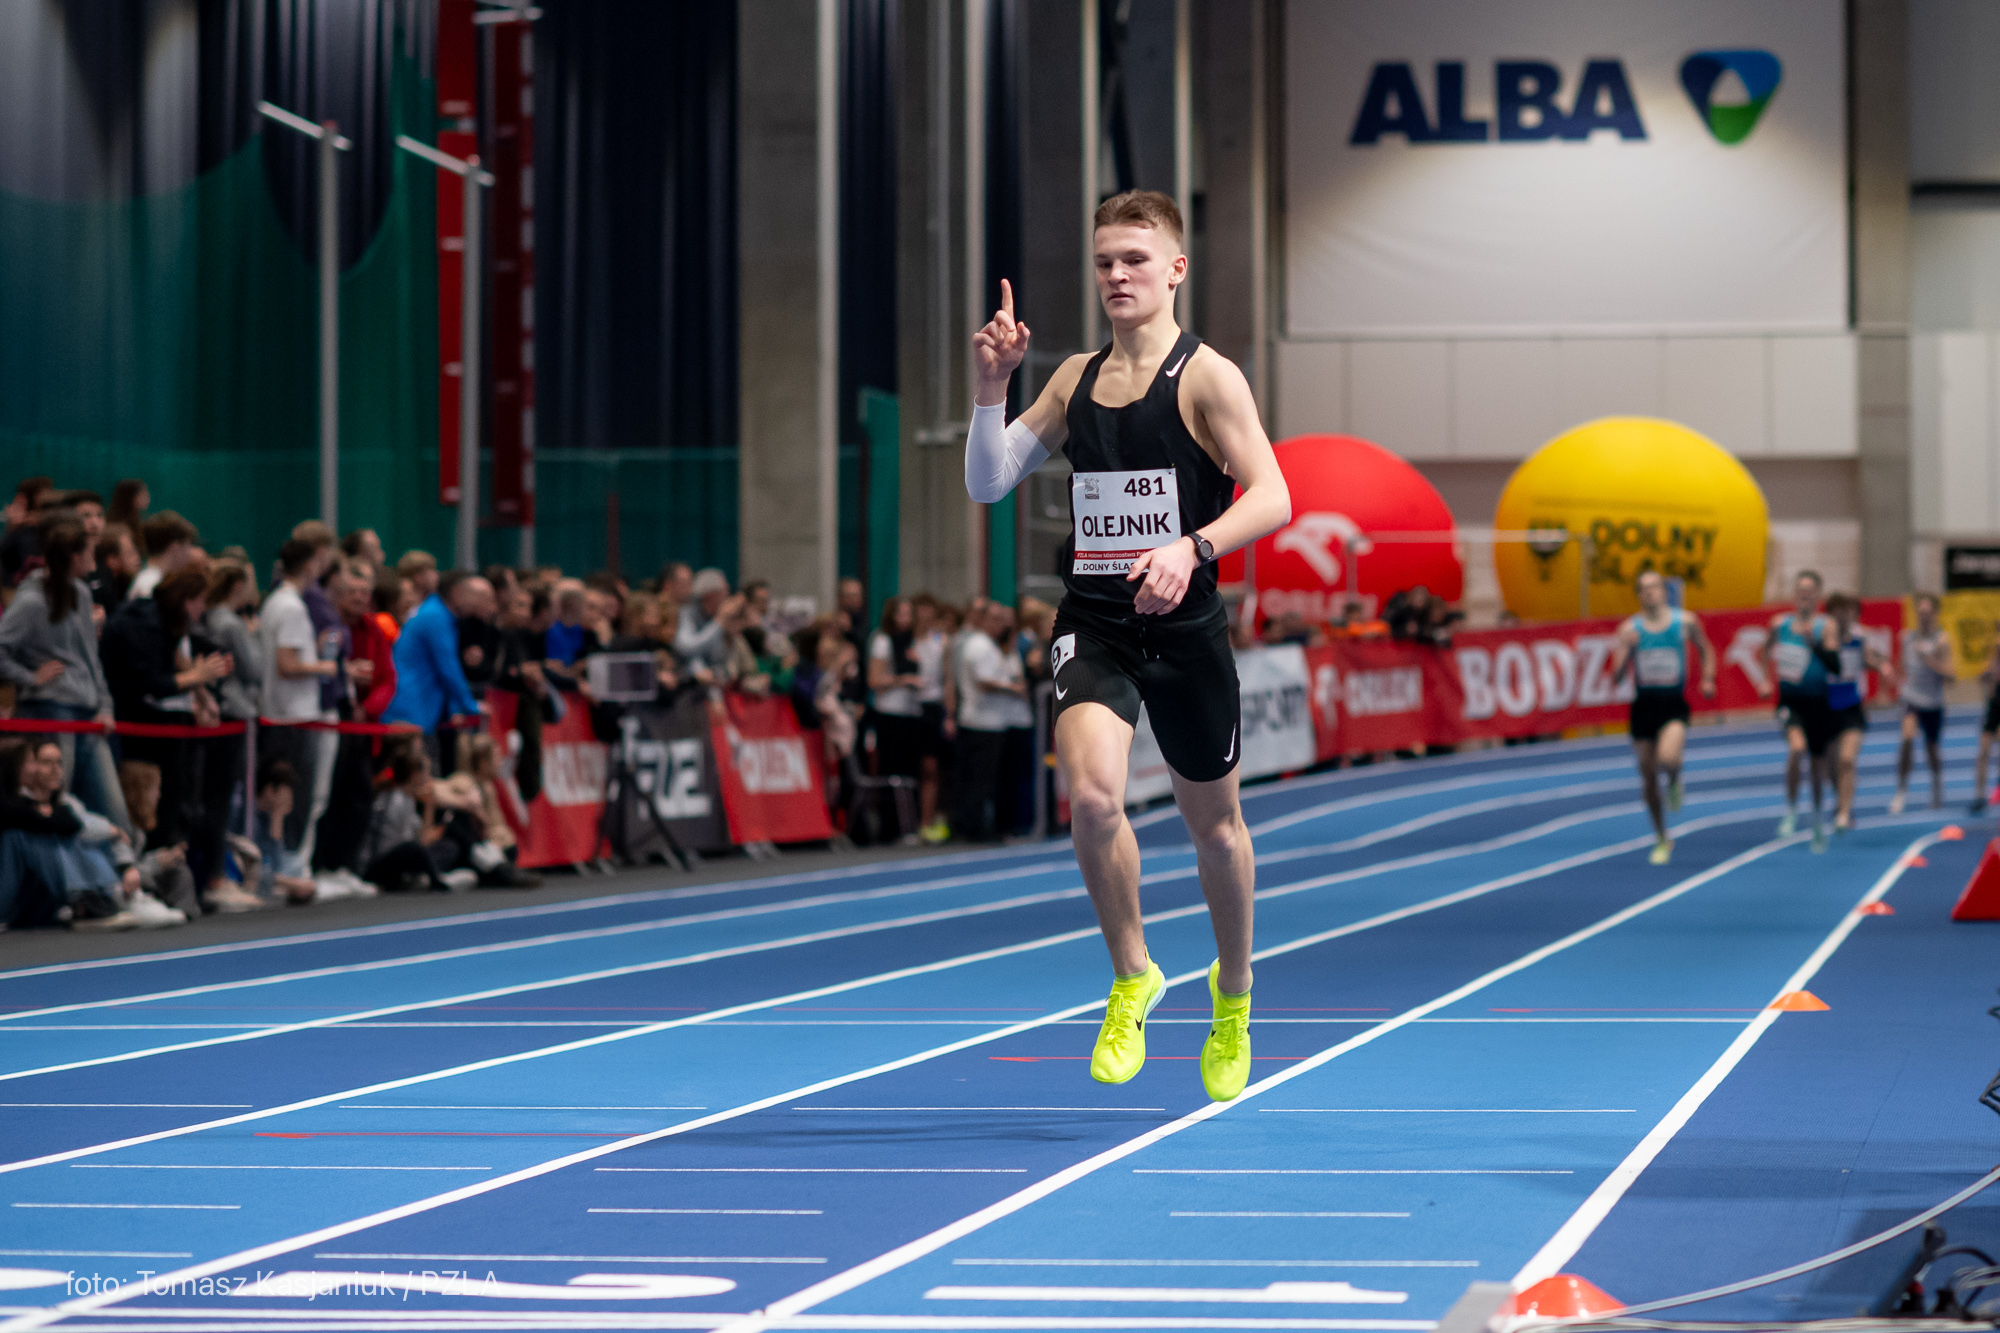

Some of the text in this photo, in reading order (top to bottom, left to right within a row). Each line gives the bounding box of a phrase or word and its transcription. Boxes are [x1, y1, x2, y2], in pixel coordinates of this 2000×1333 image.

[1349, 60, 1650, 145] ALBA
[1123, 476, 1167, 497] 481
[1081, 512, 1172, 538] OLEJNIK
[1590, 518, 1718, 552] DOLNY
[1083, 563, 1110, 571] DOLNY
